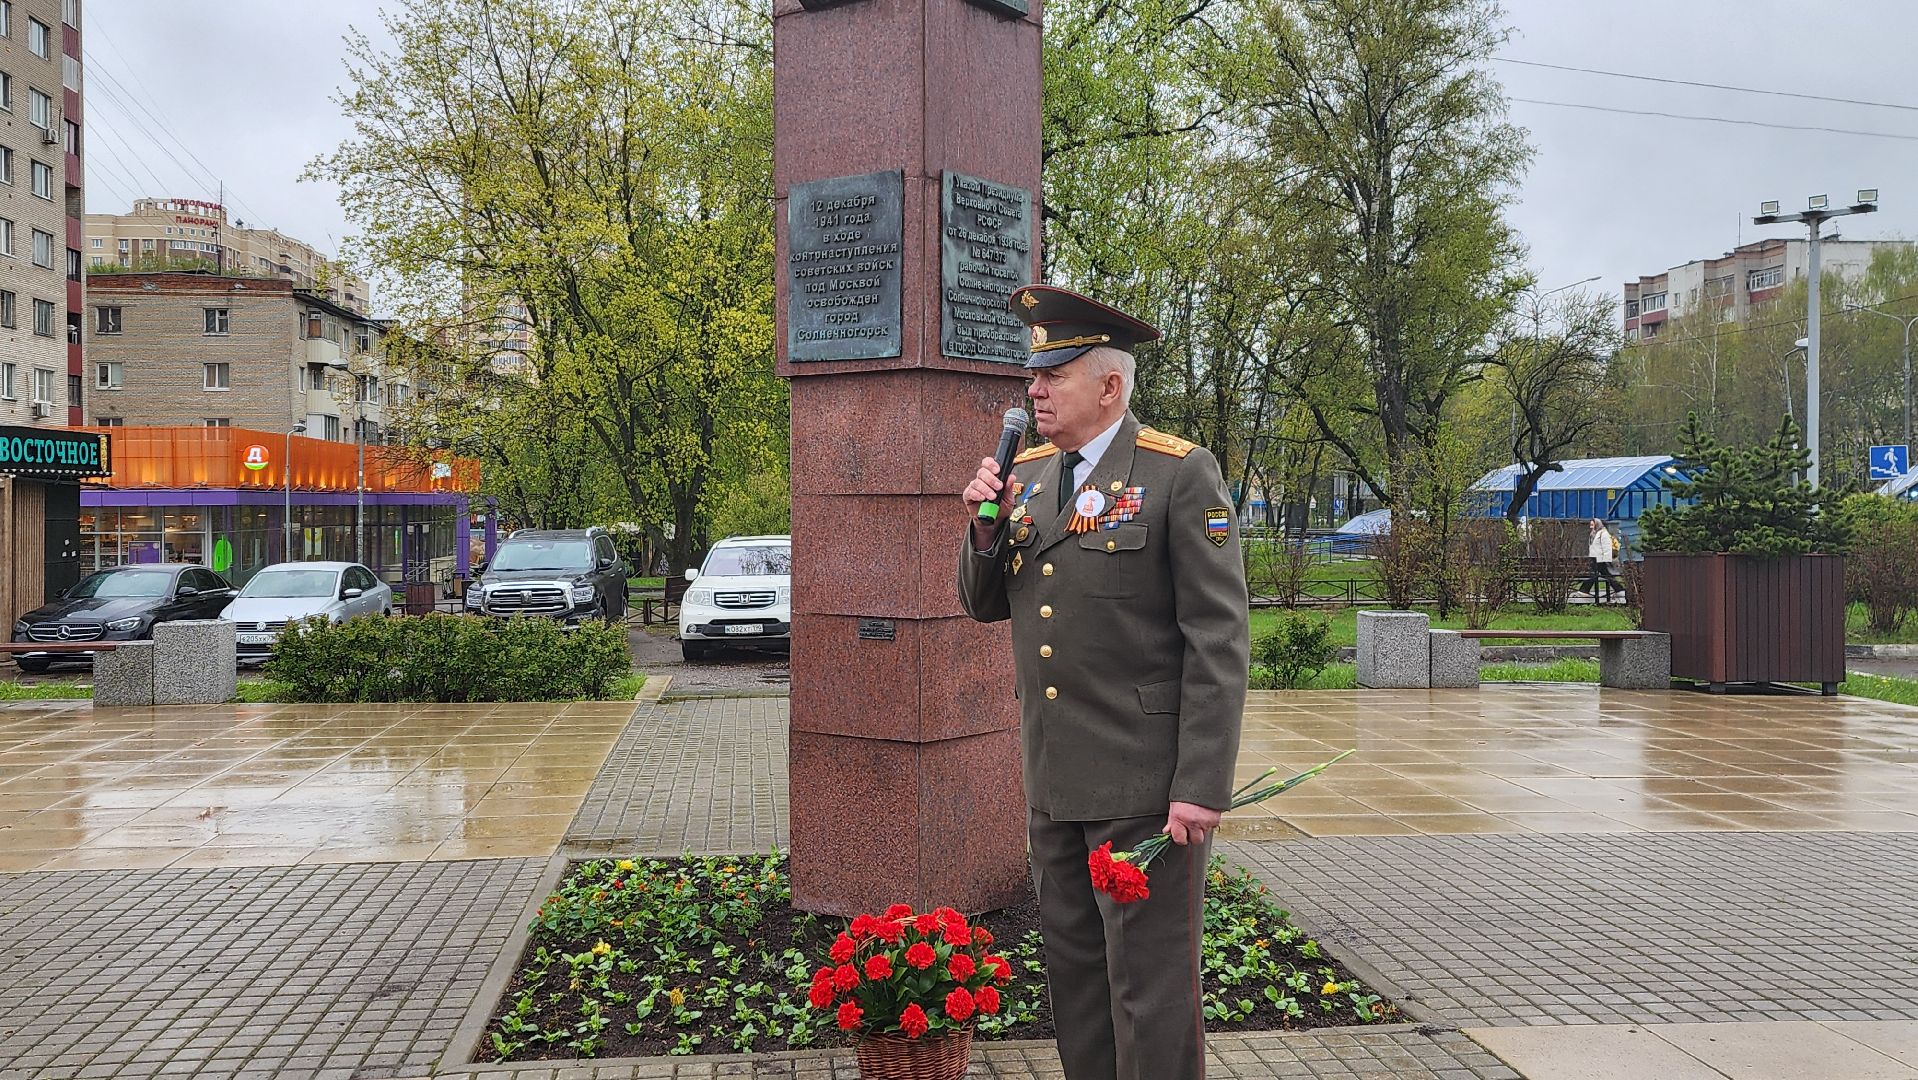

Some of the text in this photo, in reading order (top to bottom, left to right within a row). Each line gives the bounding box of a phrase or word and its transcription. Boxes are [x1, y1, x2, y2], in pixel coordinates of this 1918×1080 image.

[810, 194, 876, 212] 12 декабря
[998, 203, 1022, 219] Совета
[814, 212, 871, 228] 1941 года
[977, 214, 1002, 230] РСФСР
[823, 230, 862, 243] в ходе
[948, 227, 957, 237] от
[958, 226, 967, 239] 26
[968, 230, 996, 246] декабря
[1013, 240, 1029, 253] года
[790, 243, 898, 262] контрнаступления
[794, 258, 894, 278] советских войск
[960, 261, 1019, 280] рабочий поселок
[804, 275, 881, 293] под Москвой
[807, 293, 879, 308] освобожден
[824, 311, 859, 325] город
[954, 306, 996, 324] Московской
[798, 325, 889, 341] Солнечногорск
[957, 323, 1022, 344] был преобразован
[955, 341, 977, 356] город
[0, 436, 98, 465] ВОСТОЧНОЕ
